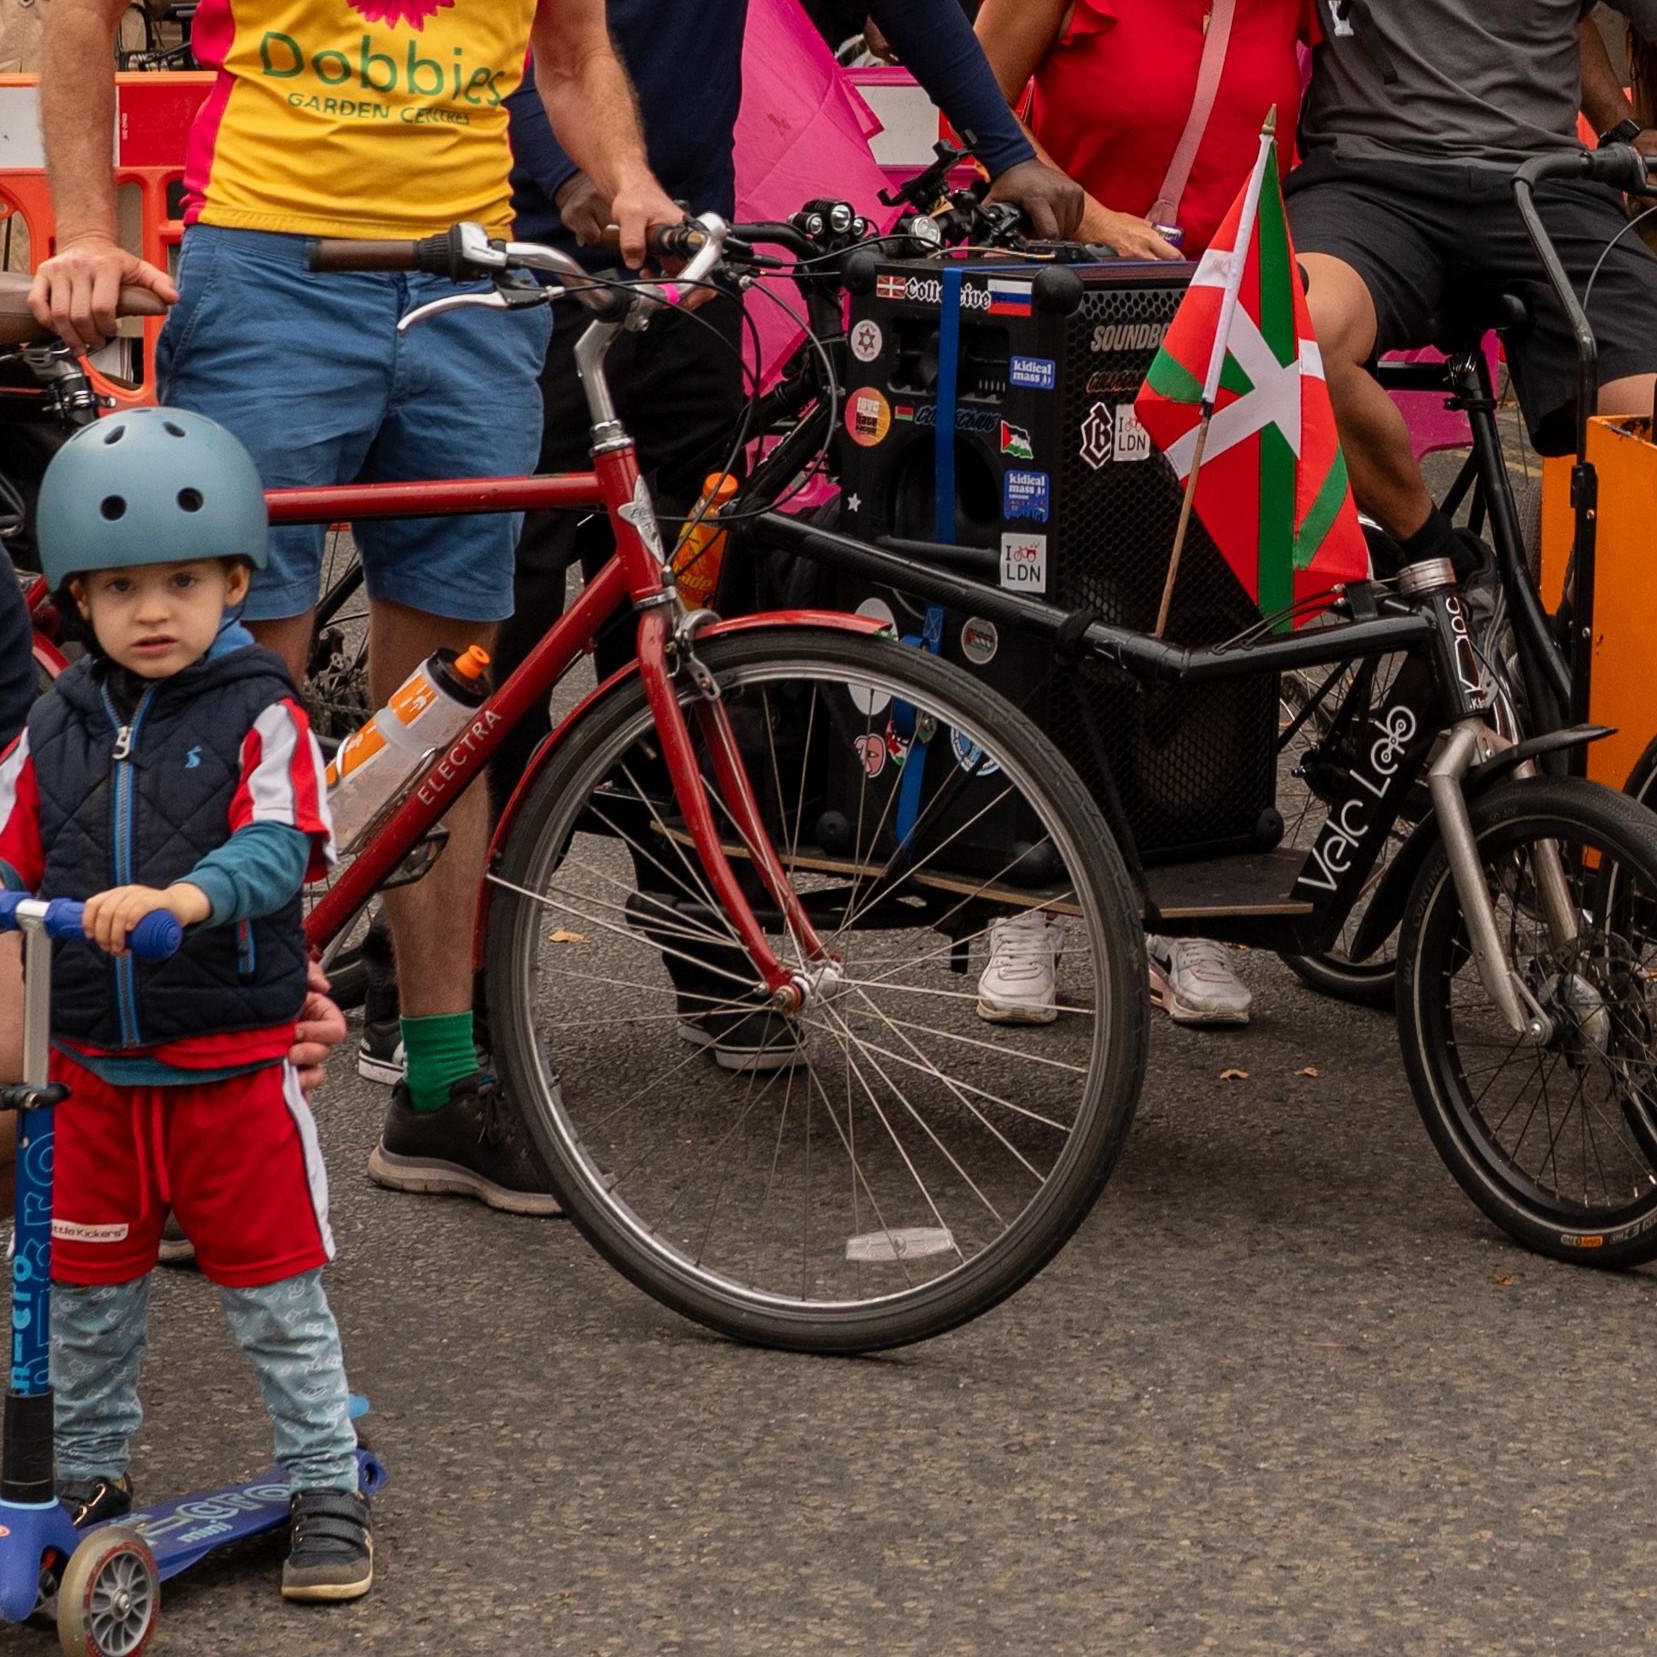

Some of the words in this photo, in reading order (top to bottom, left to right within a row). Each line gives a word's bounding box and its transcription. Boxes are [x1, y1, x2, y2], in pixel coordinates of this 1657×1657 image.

[259, 31, 506, 107] Dobbies
[287, 92, 391, 120] GARDEN
[1013, 360, 1052, 375] kidical
[1012, 371, 1041, 383] mass
[1118, 434, 1146, 452] LDN
[1008, 473, 1045, 487] kidical
[1008, 485, 1035, 495] mass
[1006, 564, 1042, 583] LDN
[417, 709, 502, 806] ELECTRA
